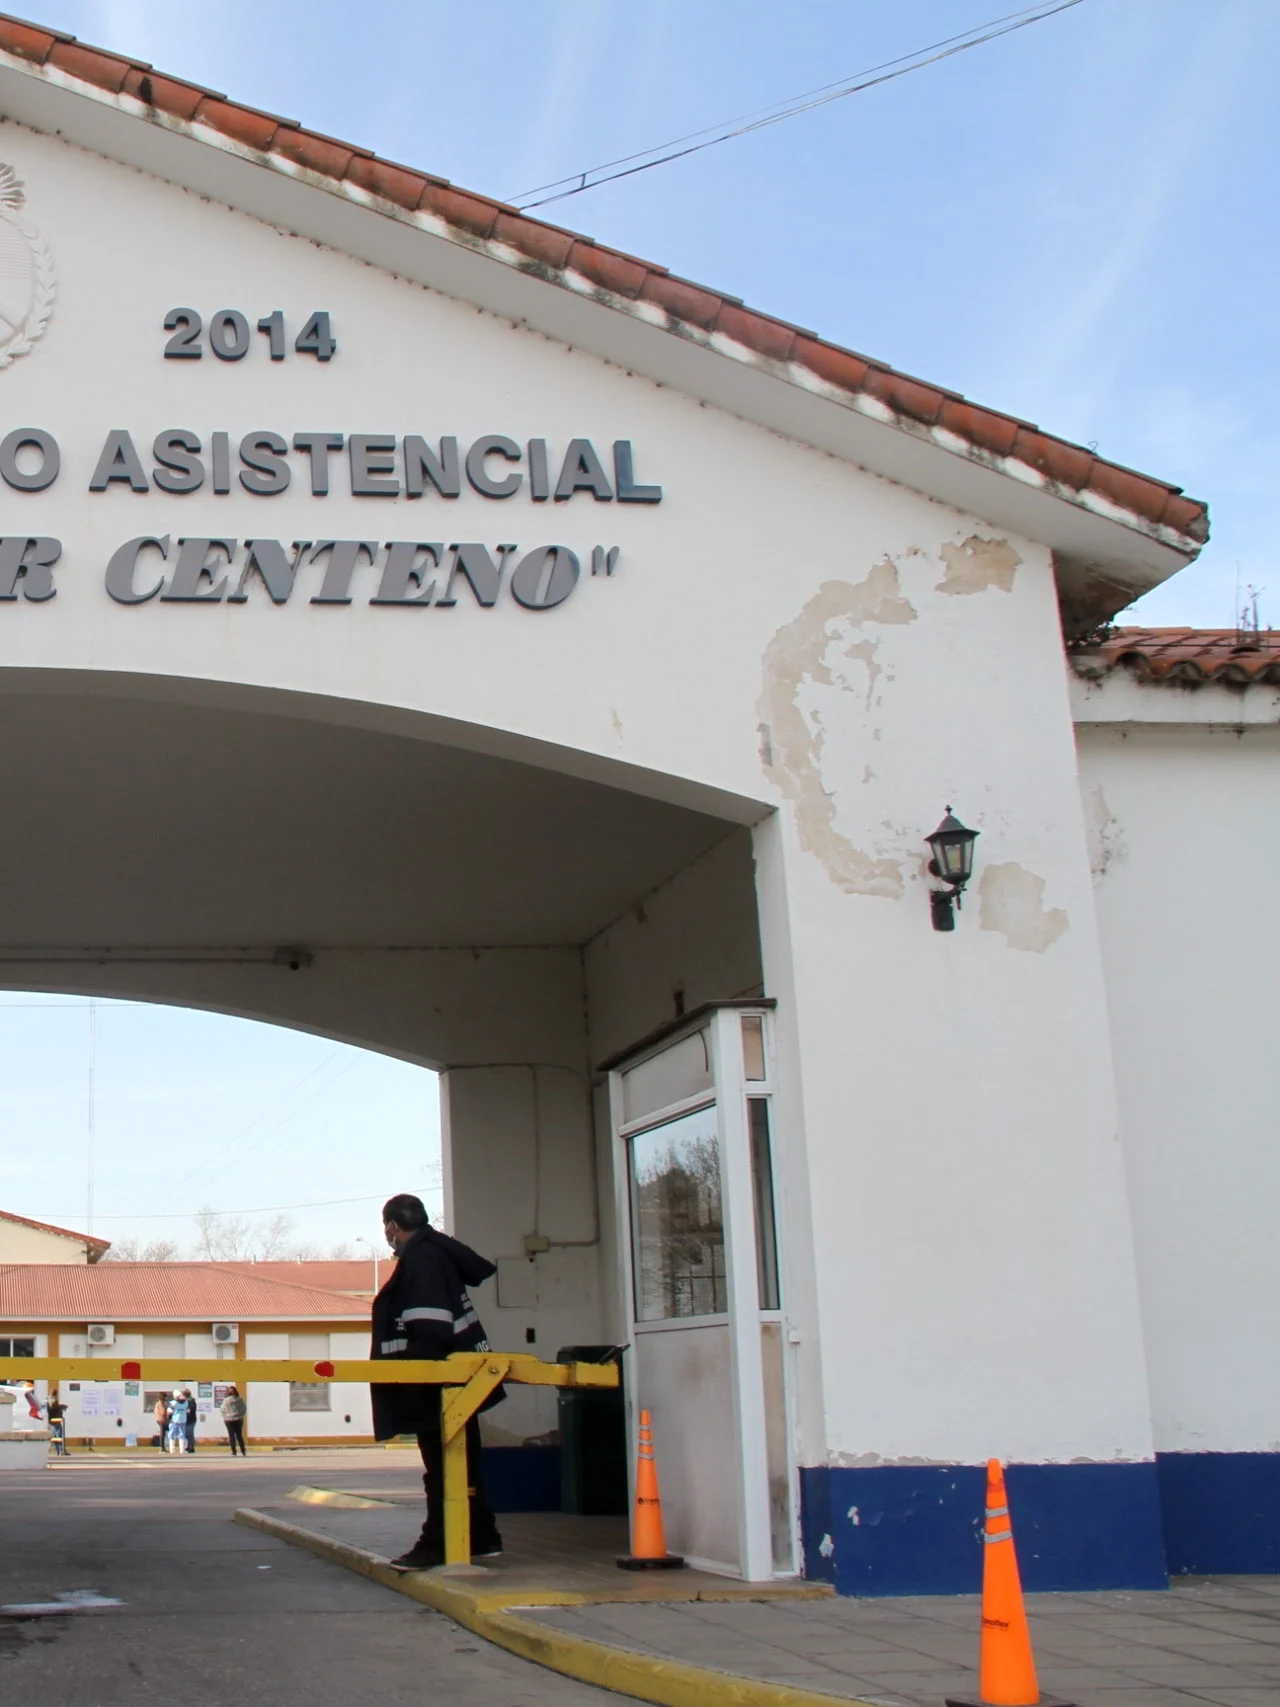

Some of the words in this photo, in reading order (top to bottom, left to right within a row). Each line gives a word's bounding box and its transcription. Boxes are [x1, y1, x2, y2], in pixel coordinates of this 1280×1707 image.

[163, 307, 337, 361] 2014
[88, 428, 662, 503] ASISTENCIAL
[104, 533, 620, 610] CENTENO"
